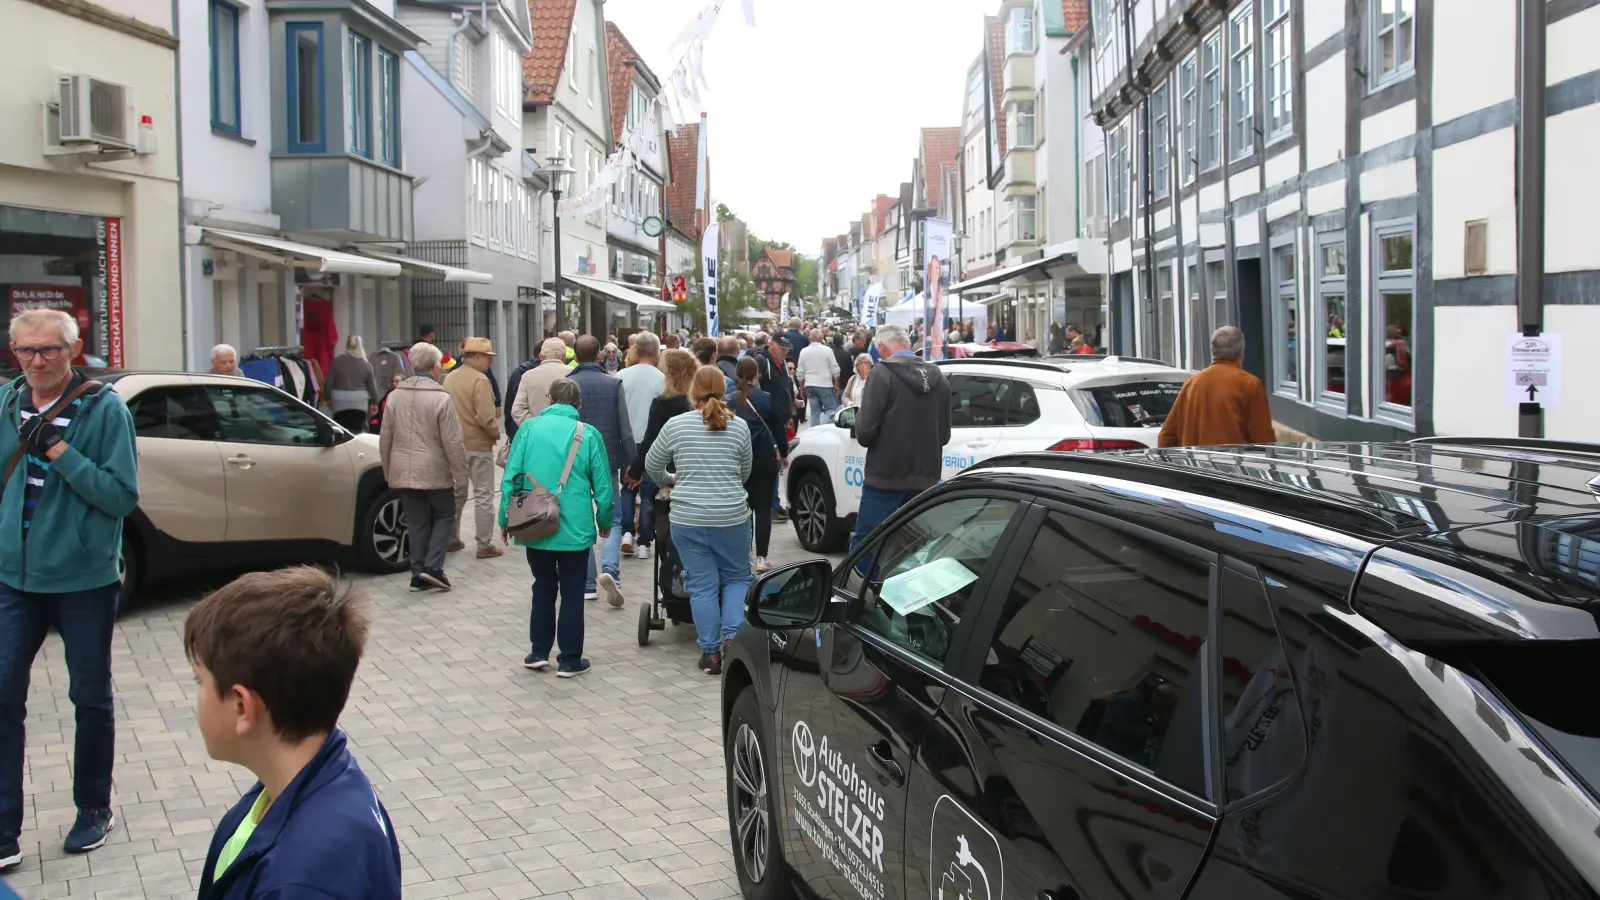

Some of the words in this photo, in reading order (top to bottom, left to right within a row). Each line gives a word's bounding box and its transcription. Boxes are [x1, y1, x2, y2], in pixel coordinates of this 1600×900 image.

[97, 220, 106, 246] FÜR
[98, 250, 107, 285] AUCH
[100, 289, 109, 356] BERATUNG
[844, 455, 856, 465] DER
[818, 734, 885, 822] Autohaus
[817, 770, 884, 874] STELZER
[837, 835, 848, 857] Tel.
[847, 847, 885, 898] 05721/4515
